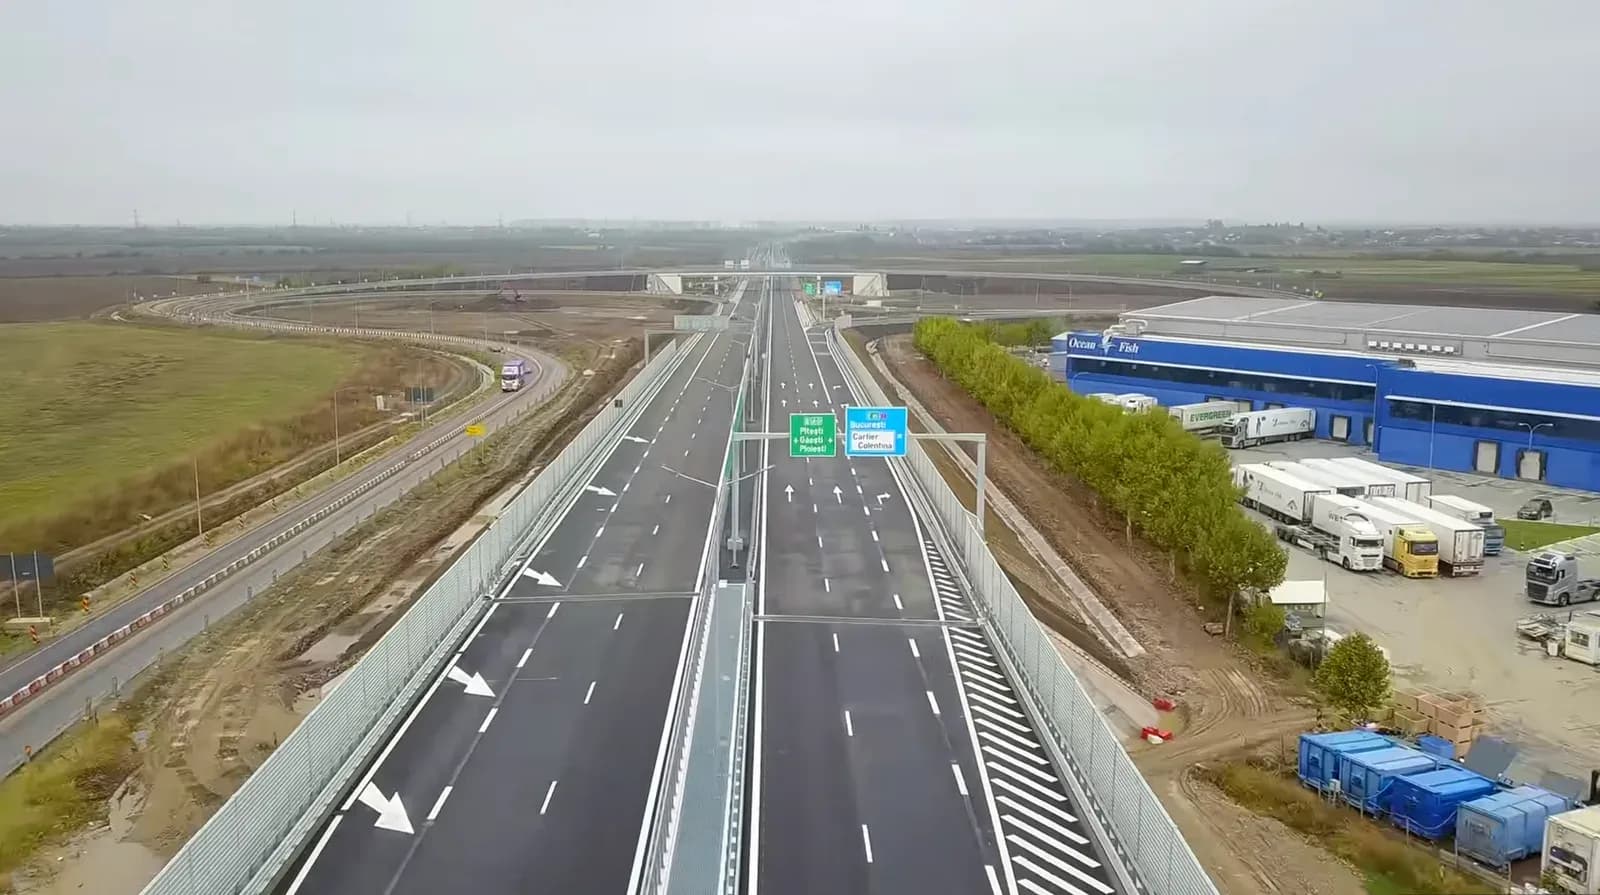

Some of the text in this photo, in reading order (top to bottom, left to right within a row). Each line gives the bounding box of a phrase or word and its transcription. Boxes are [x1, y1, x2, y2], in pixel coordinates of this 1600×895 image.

[1069, 337, 1139, 354] Ocean Fish
[1190, 410, 1232, 422] EVERGREEN
[852, 433, 879, 441] Cartier
[857, 441, 893, 449] Colentina
